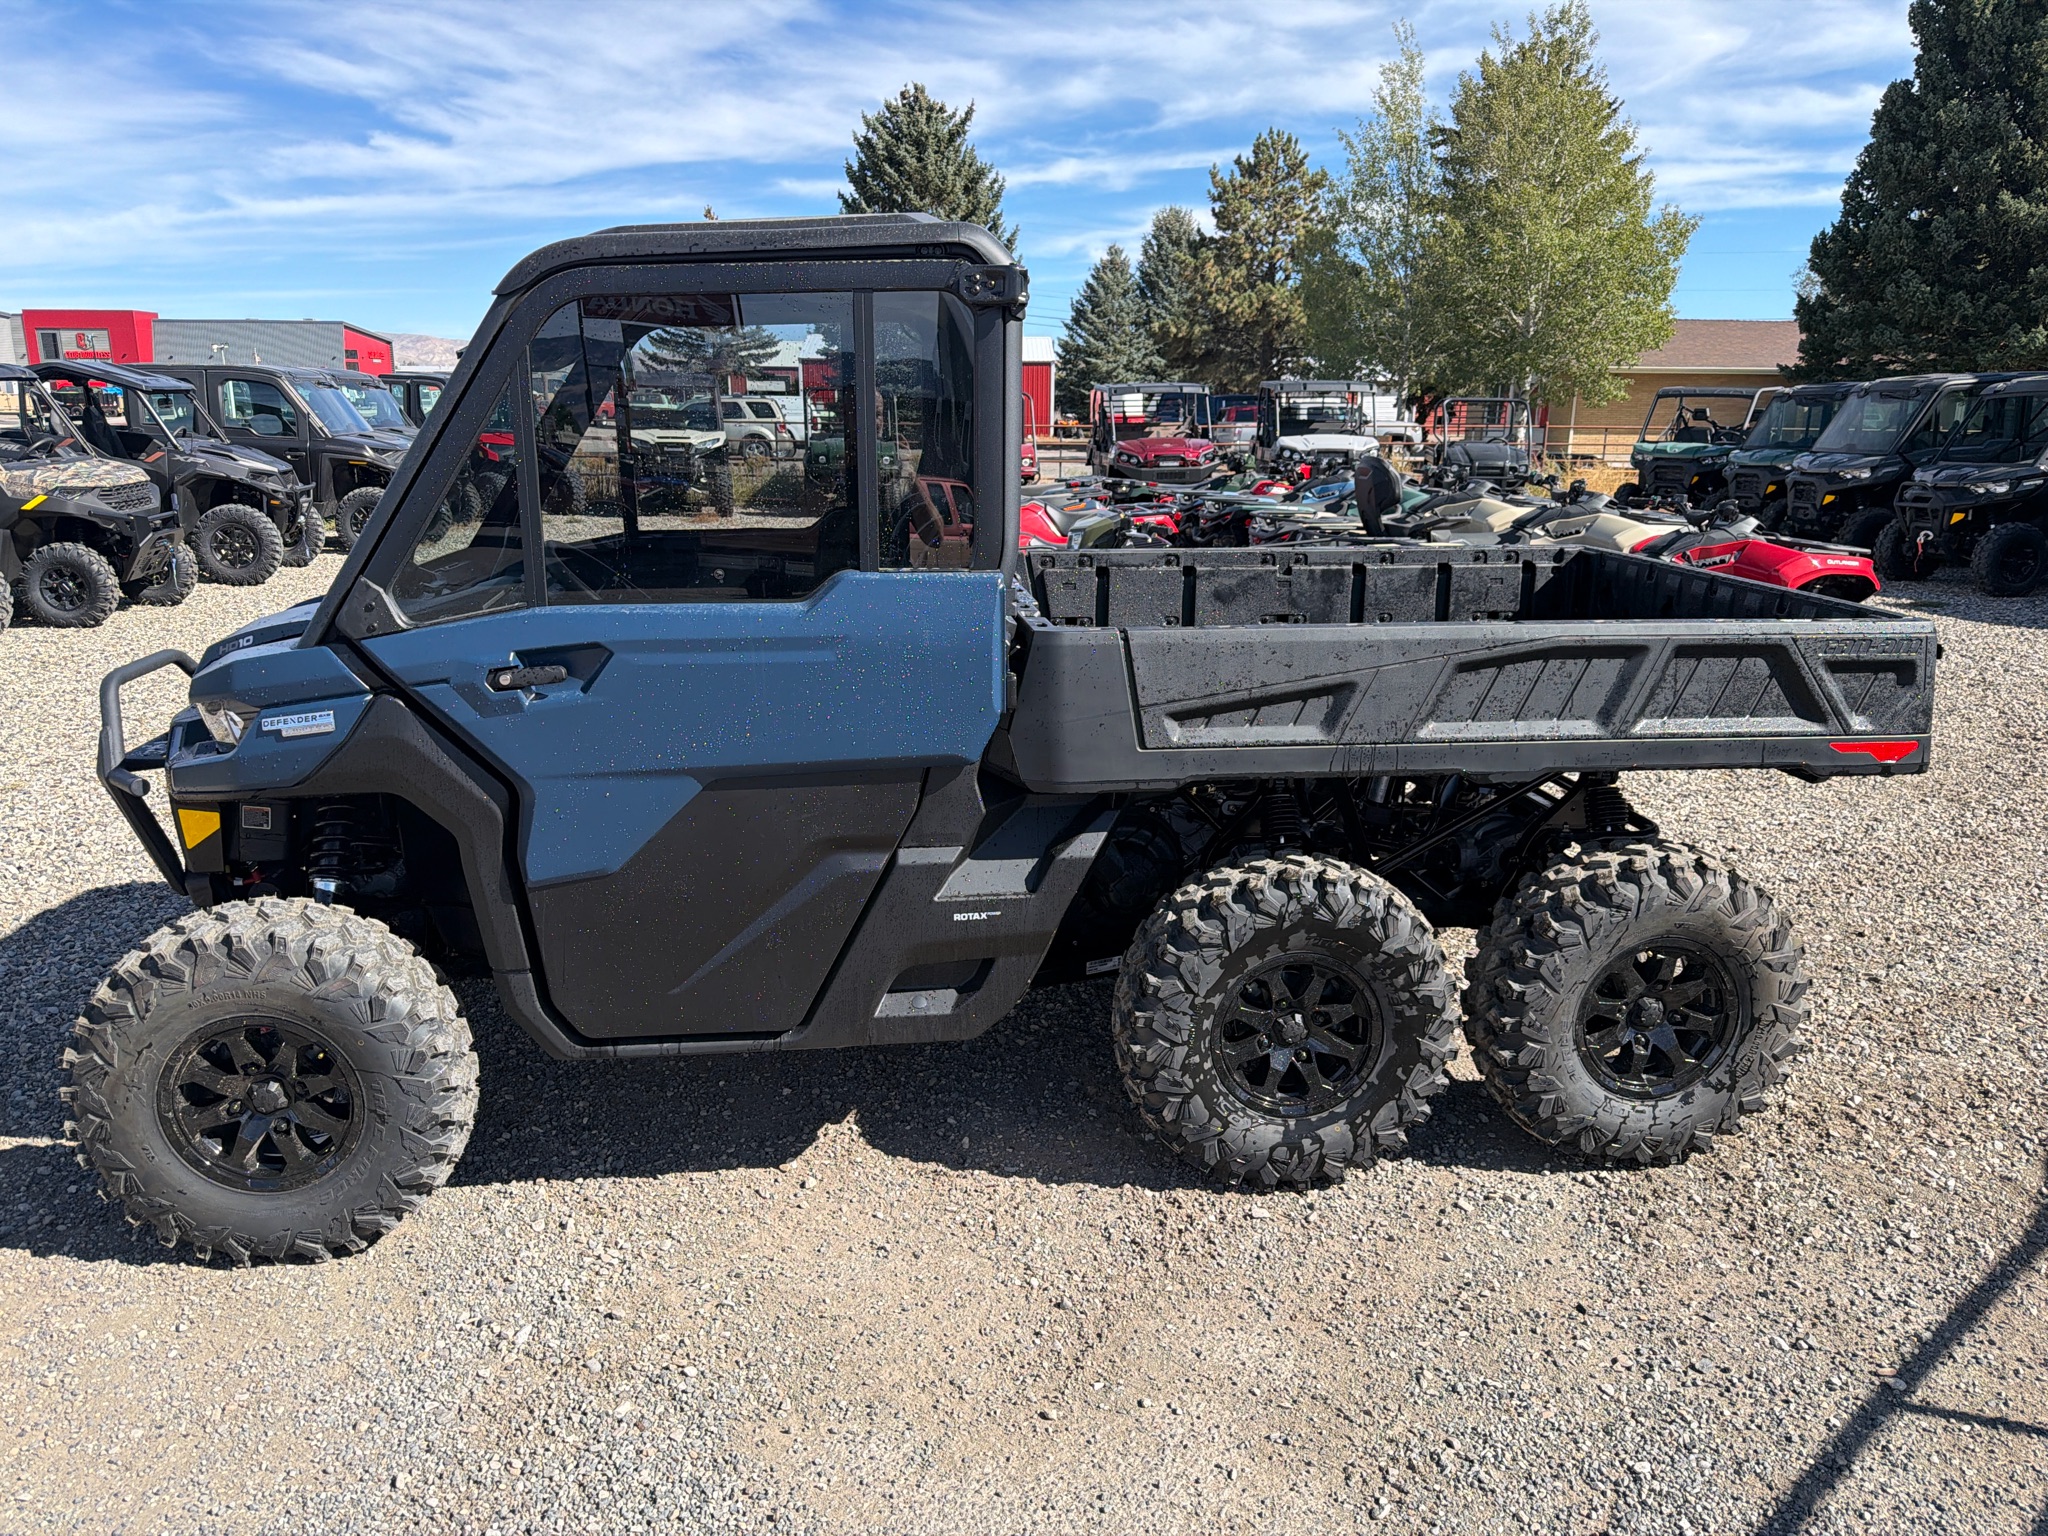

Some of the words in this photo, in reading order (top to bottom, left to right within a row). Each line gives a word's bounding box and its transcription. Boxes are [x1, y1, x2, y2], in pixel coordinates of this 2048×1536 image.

[218, 634, 254, 656] HD10
[262, 714, 318, 728] DEFENDER
[953, 911, 988, 921] ROTAX
